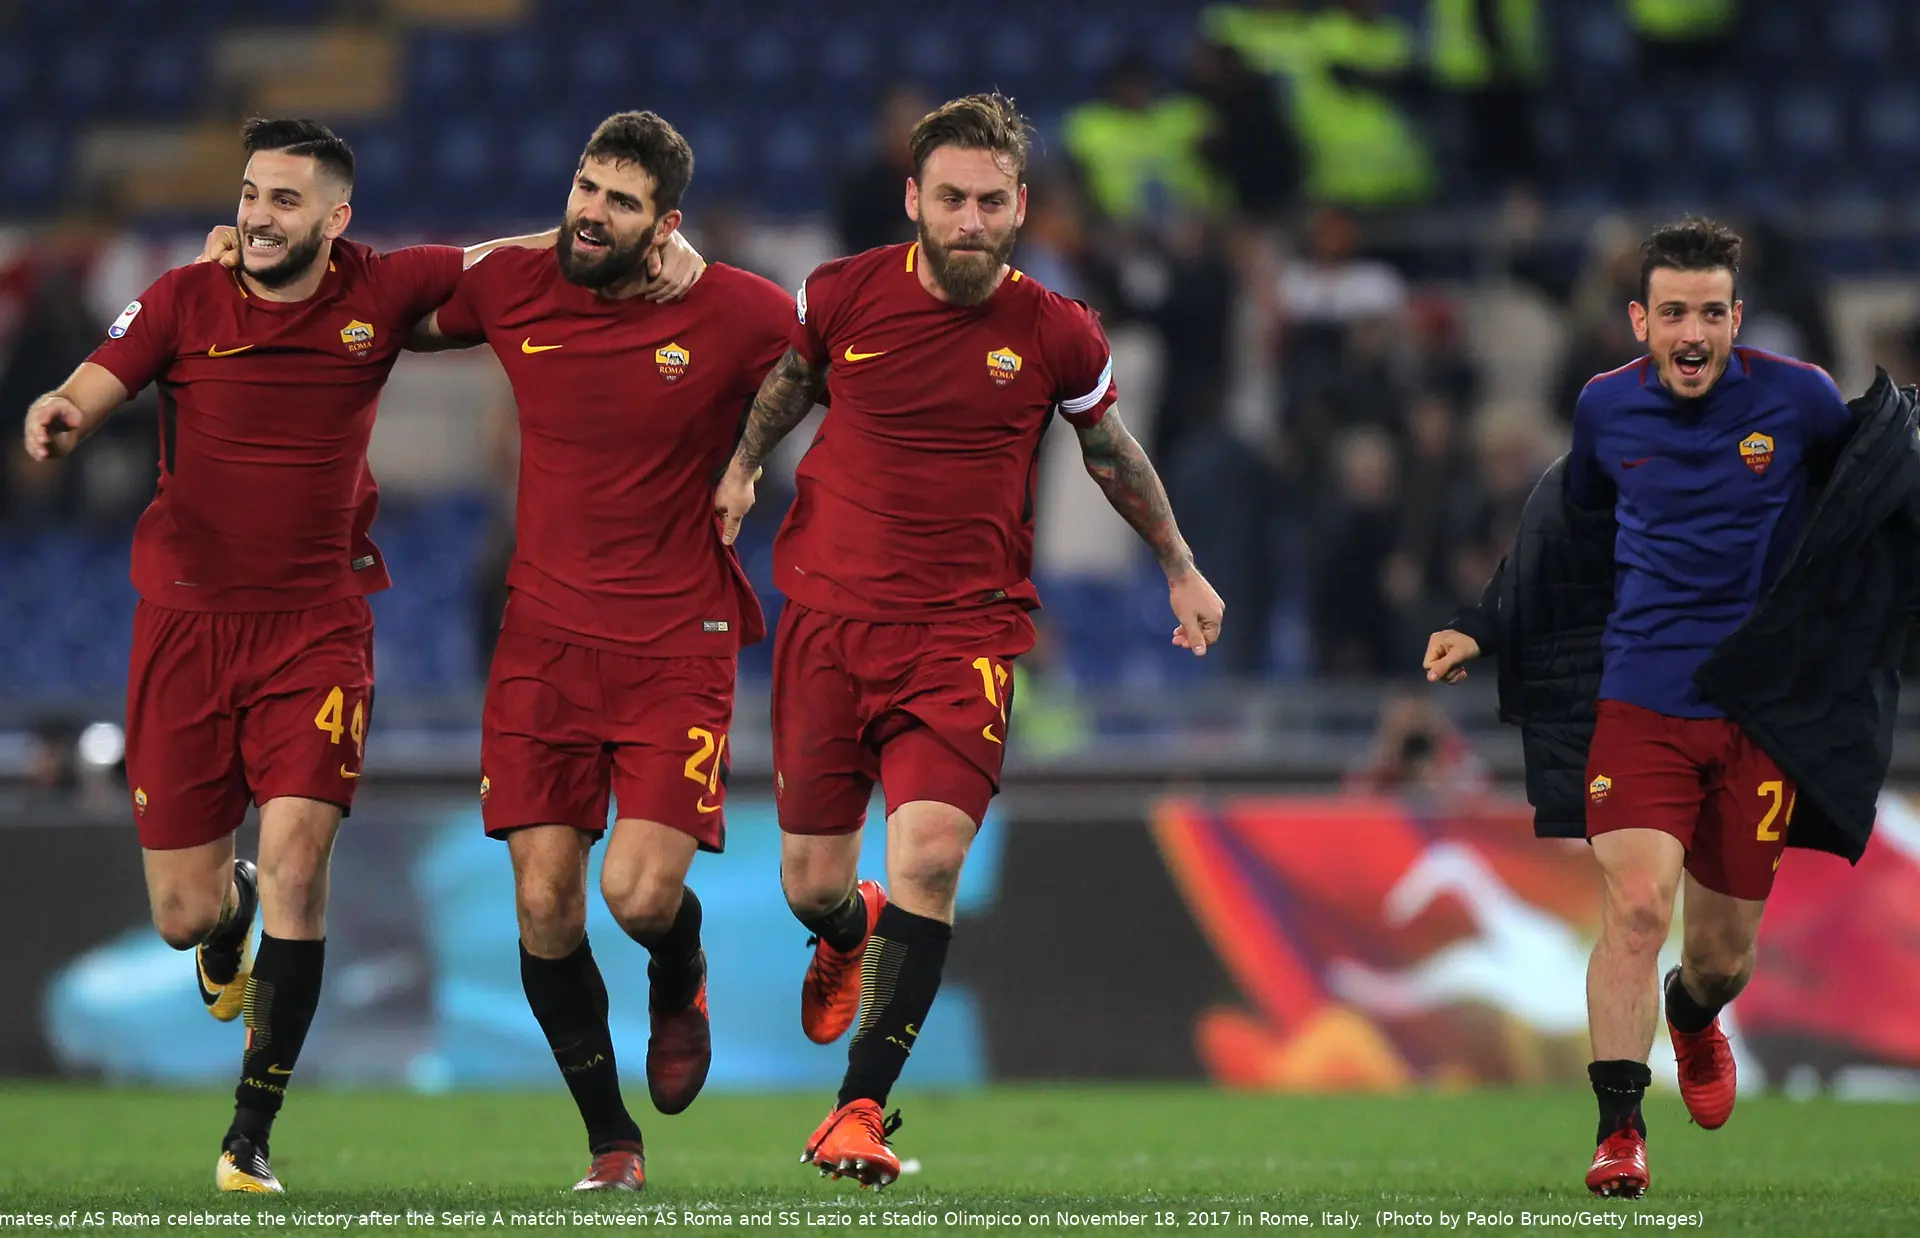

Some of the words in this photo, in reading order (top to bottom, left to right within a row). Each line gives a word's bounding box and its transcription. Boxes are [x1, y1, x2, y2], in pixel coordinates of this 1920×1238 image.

[348, 341, 373, 352] ROMA
[659, 366, 685, 375] ROMA
[989, 369, 1015, 380] ROMA
[1746, 455, 1771, 465] ROMA
[314, 686, 363, 758] 44
[1756, 780, 1797, 842] 2
